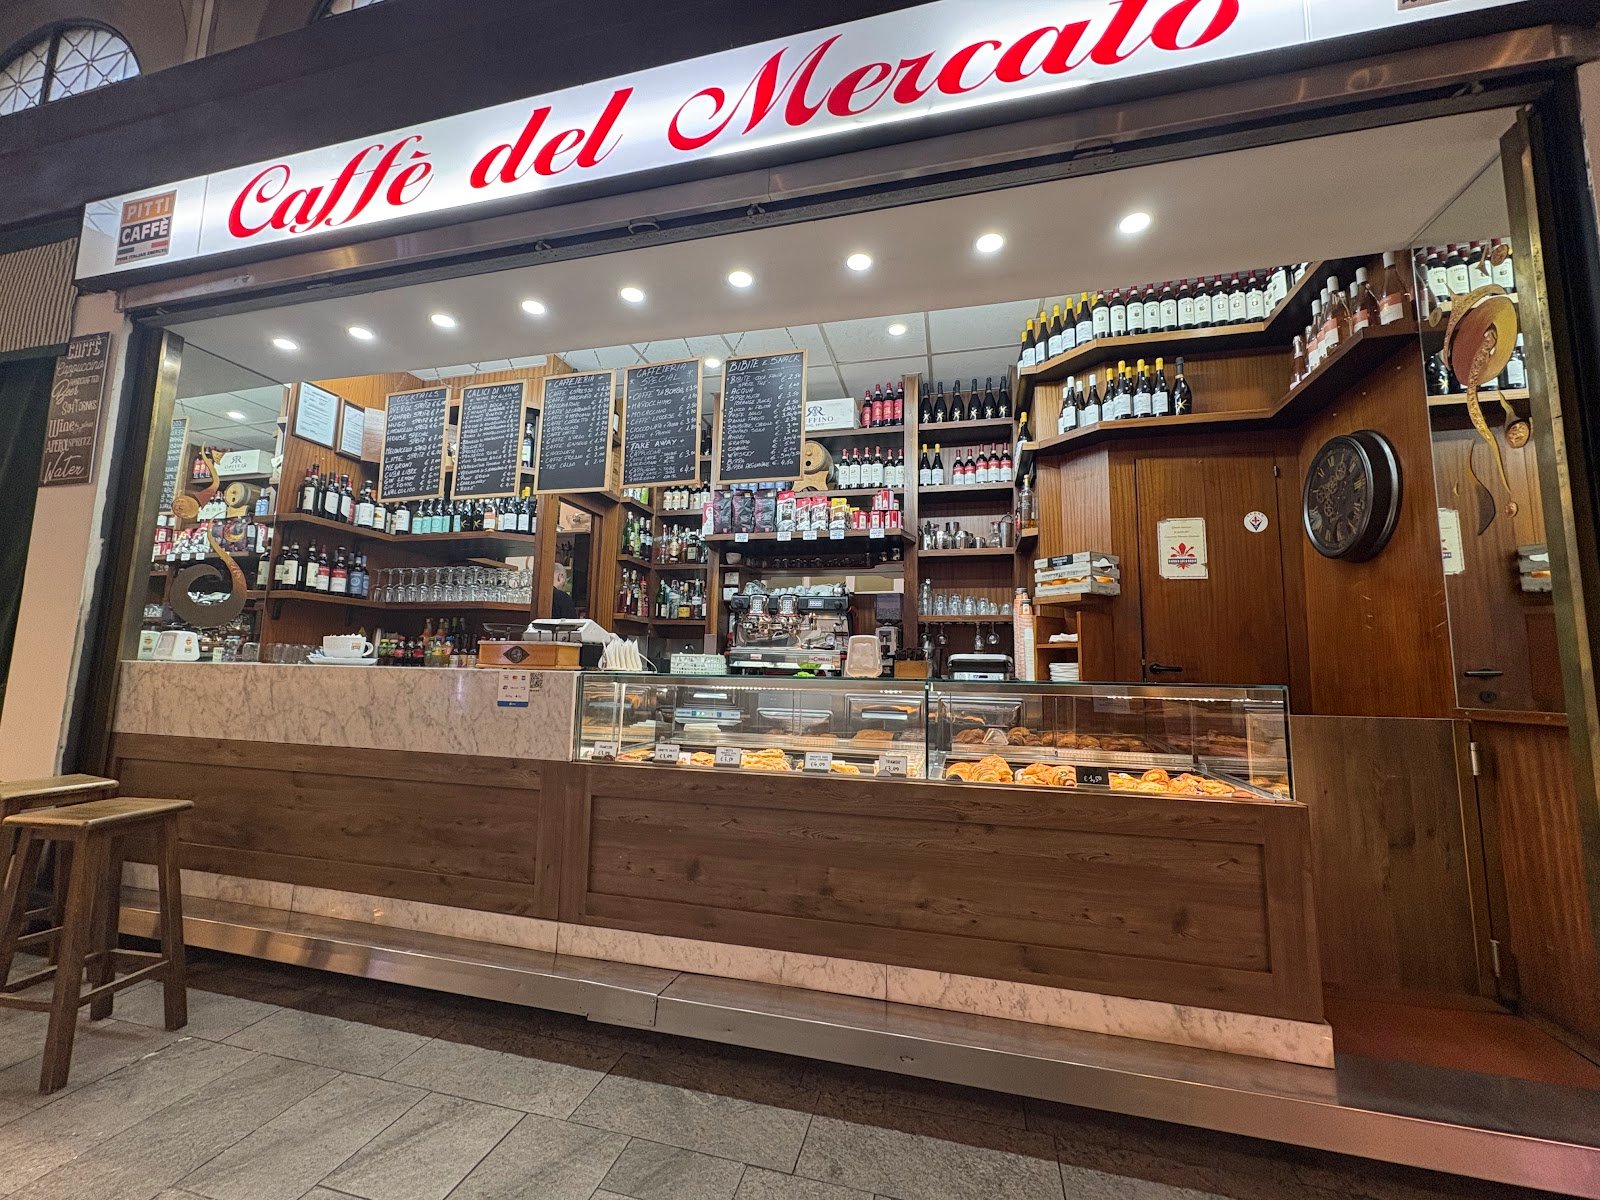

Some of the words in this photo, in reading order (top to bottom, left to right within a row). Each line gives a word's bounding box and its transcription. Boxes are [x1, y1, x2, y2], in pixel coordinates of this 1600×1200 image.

[228, 136, 432, 238] Caffè
[470, 88, 633, 189] del
[668, 0, 1239, 151] Mercato
[127, 197, 170, 220] PITTI
[122, 218, 169, 243] CAFFÈ
[57, 360, 104, 377] Cappuccino
[729, 359, 759, 372] BIBITE
[770, 355, 800, 365] SNACK
[637, 363, 687, 378] CAFFETERIA
[640, 374, 681, 386] SPECIAL
[397, 391, 439, 402] COCKTAILS
[467, 388, 490, 398] CALICI
[631, 399, 672, 410] MAROCCHINO
[49, 418, 75, 437] Wine
[387, 434, 407, 442] HOUSE
[630, 442, 651, 450] TAKE
[654, 439, 677, 447] AWAY
[385, 455, 404, 463] LIME
[44, 452, 84, 484] Water
[385, 462, 413, 471] NEGRONI
